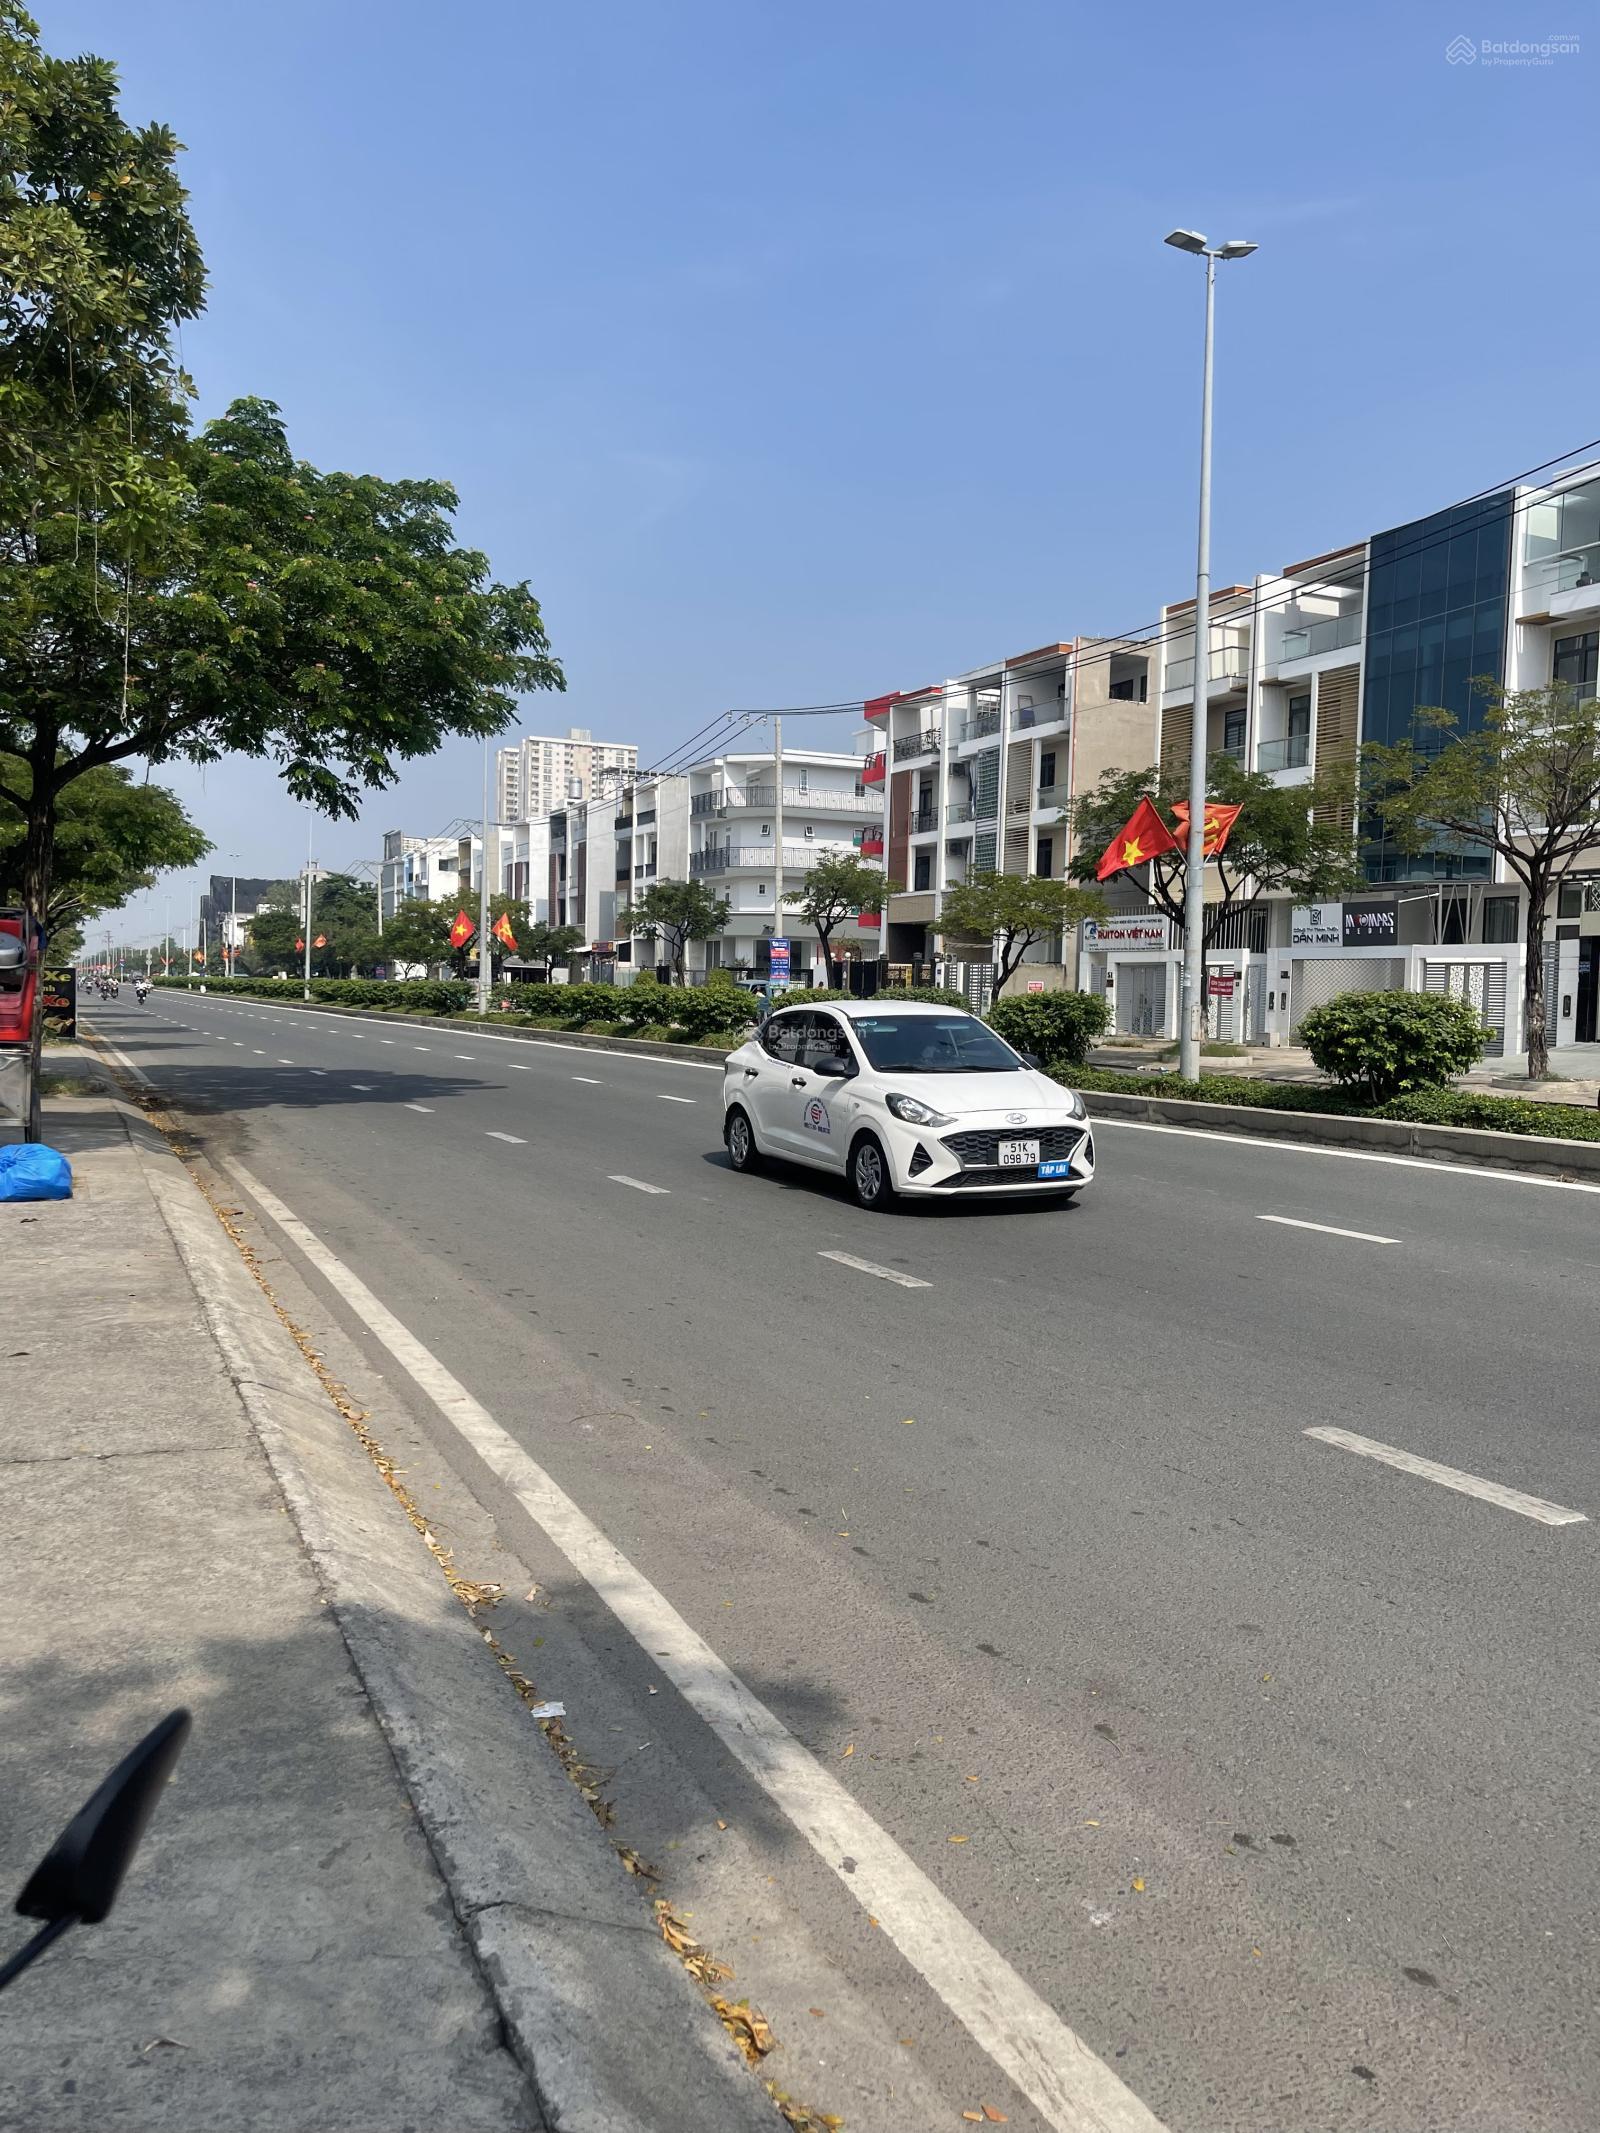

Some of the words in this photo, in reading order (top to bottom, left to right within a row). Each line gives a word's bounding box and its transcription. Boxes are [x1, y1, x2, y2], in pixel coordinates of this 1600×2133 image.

[1097, 928, 1125, 940] RUITON
[1144, 928, 1163, 939] NAM
[1316, 933, 1340, 943] MINH
[43, 970, 71, 982] Xe
[1010, 1142, 1028, 1152] 51K
